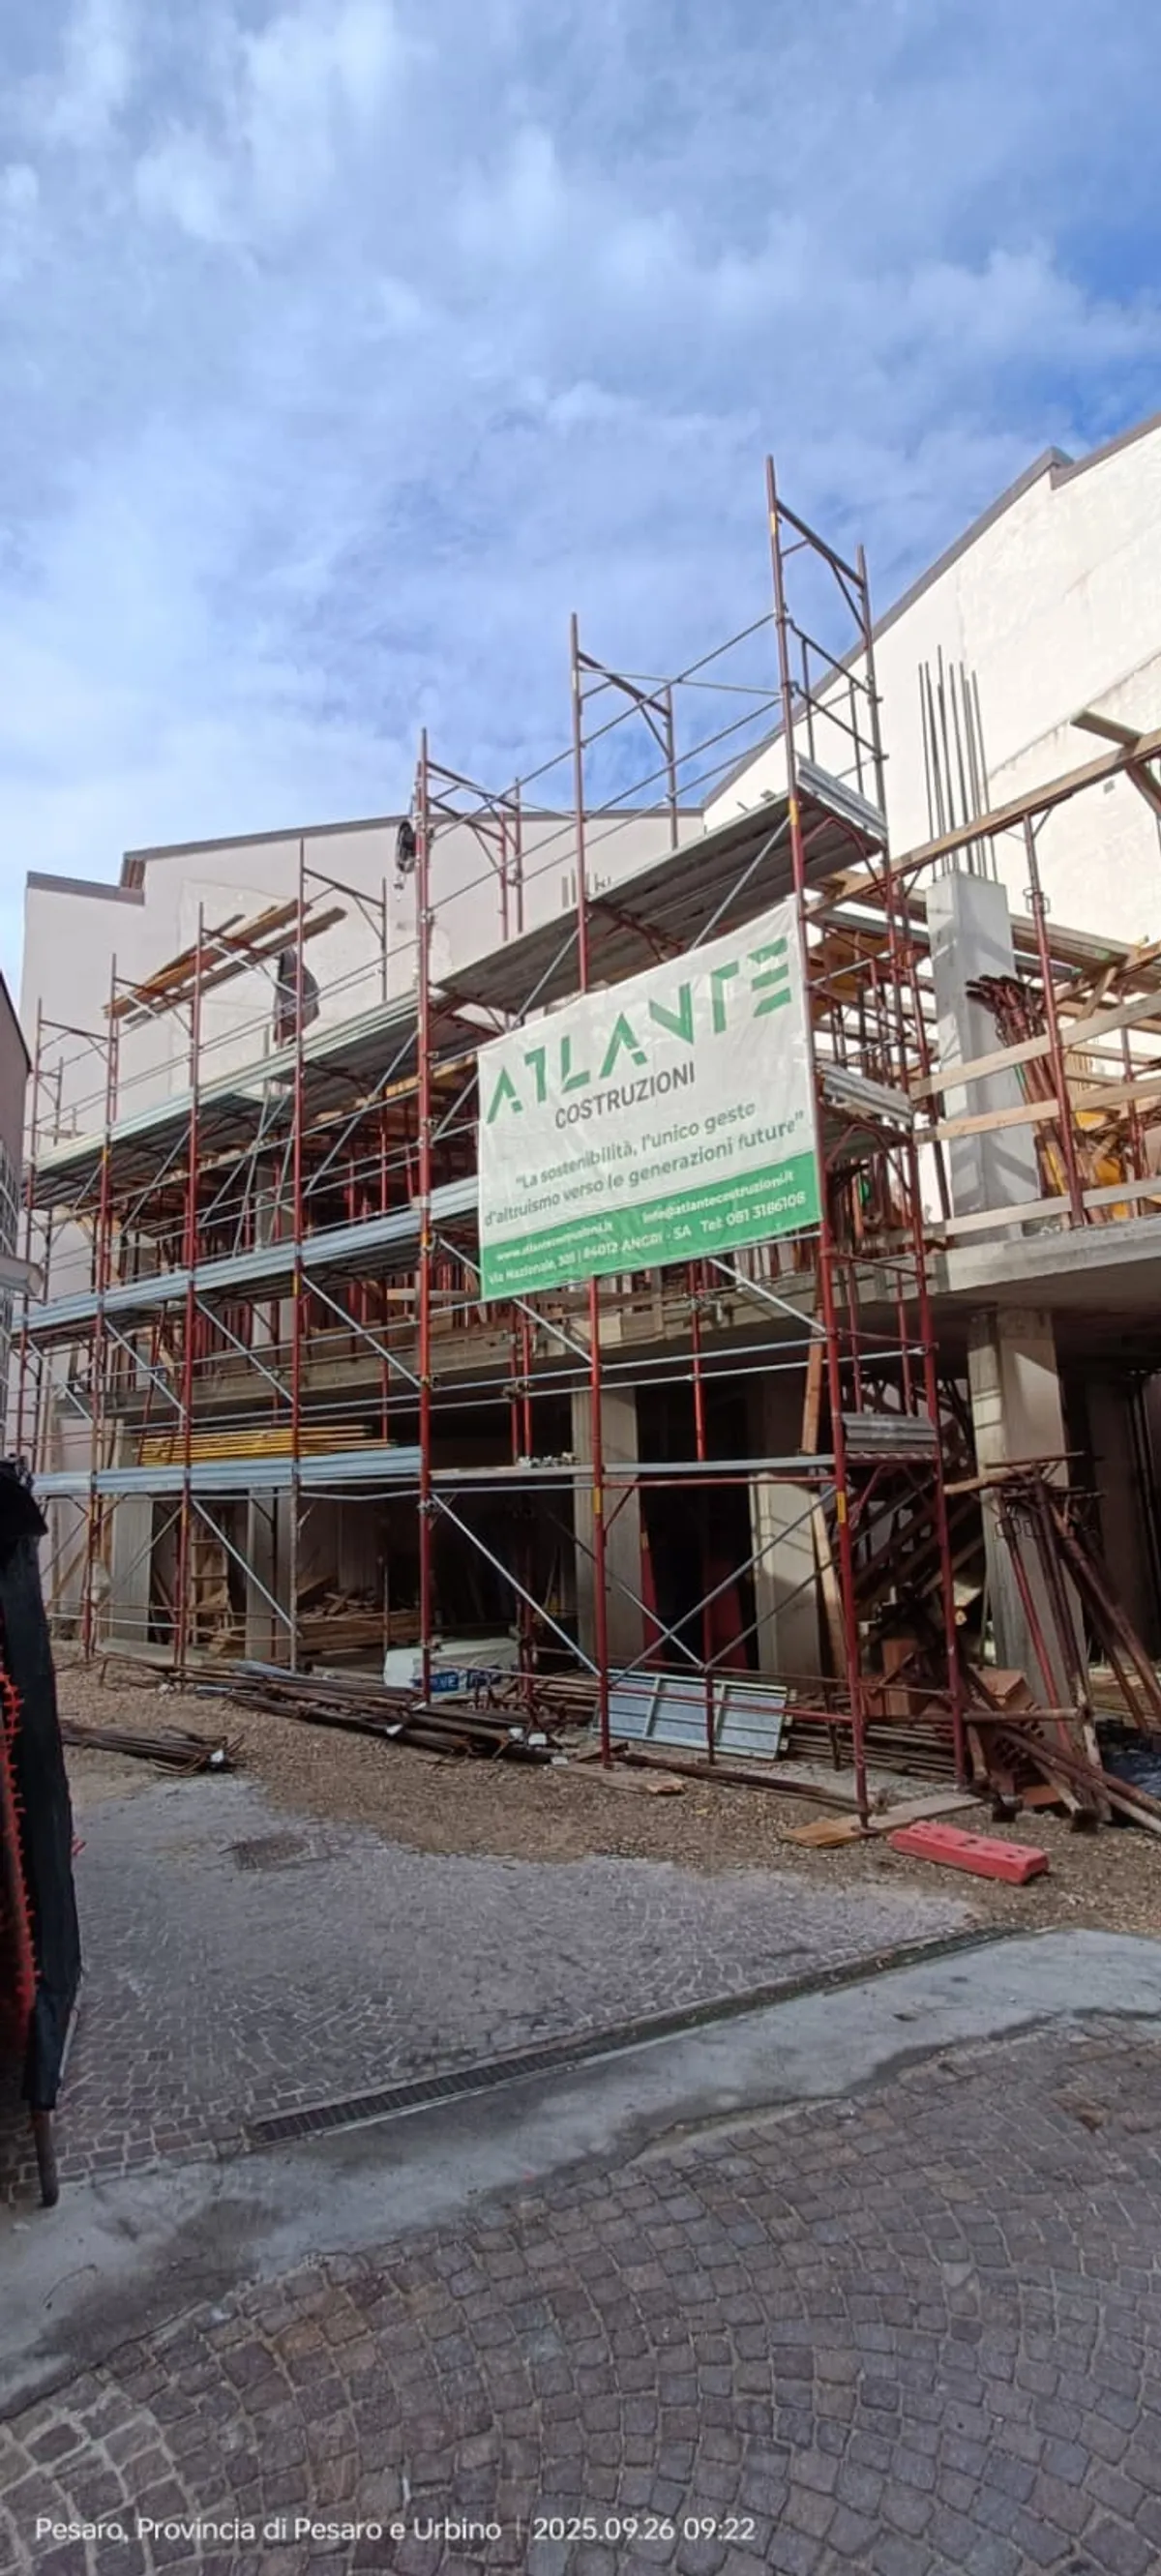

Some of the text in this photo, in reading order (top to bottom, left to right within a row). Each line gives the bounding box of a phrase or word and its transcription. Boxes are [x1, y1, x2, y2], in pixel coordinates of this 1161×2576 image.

[486, 936, 792, 1125] ATLANTE
[554, 1061, 695, 1129] COSTRUZIONI
[485, 1193, 561, 1226] d'altruismo
[563, 1179, 605, 1201] verso
[608, 1173, 625, 1190] le
[628, 1137, 733, 1187] generazioni
[541, 1140, 638, 1183] sostenibilità,
[641, 1122, 700, 1151] l'unico
[704, 1103, 756, 1134] gesto
[488, 1272, 504, 1286] Via
[622, 1231, 663, 1252] ANGRI
[673, 1225, 692, 1240] SA
[727, 1209, 750, 1227] 081
